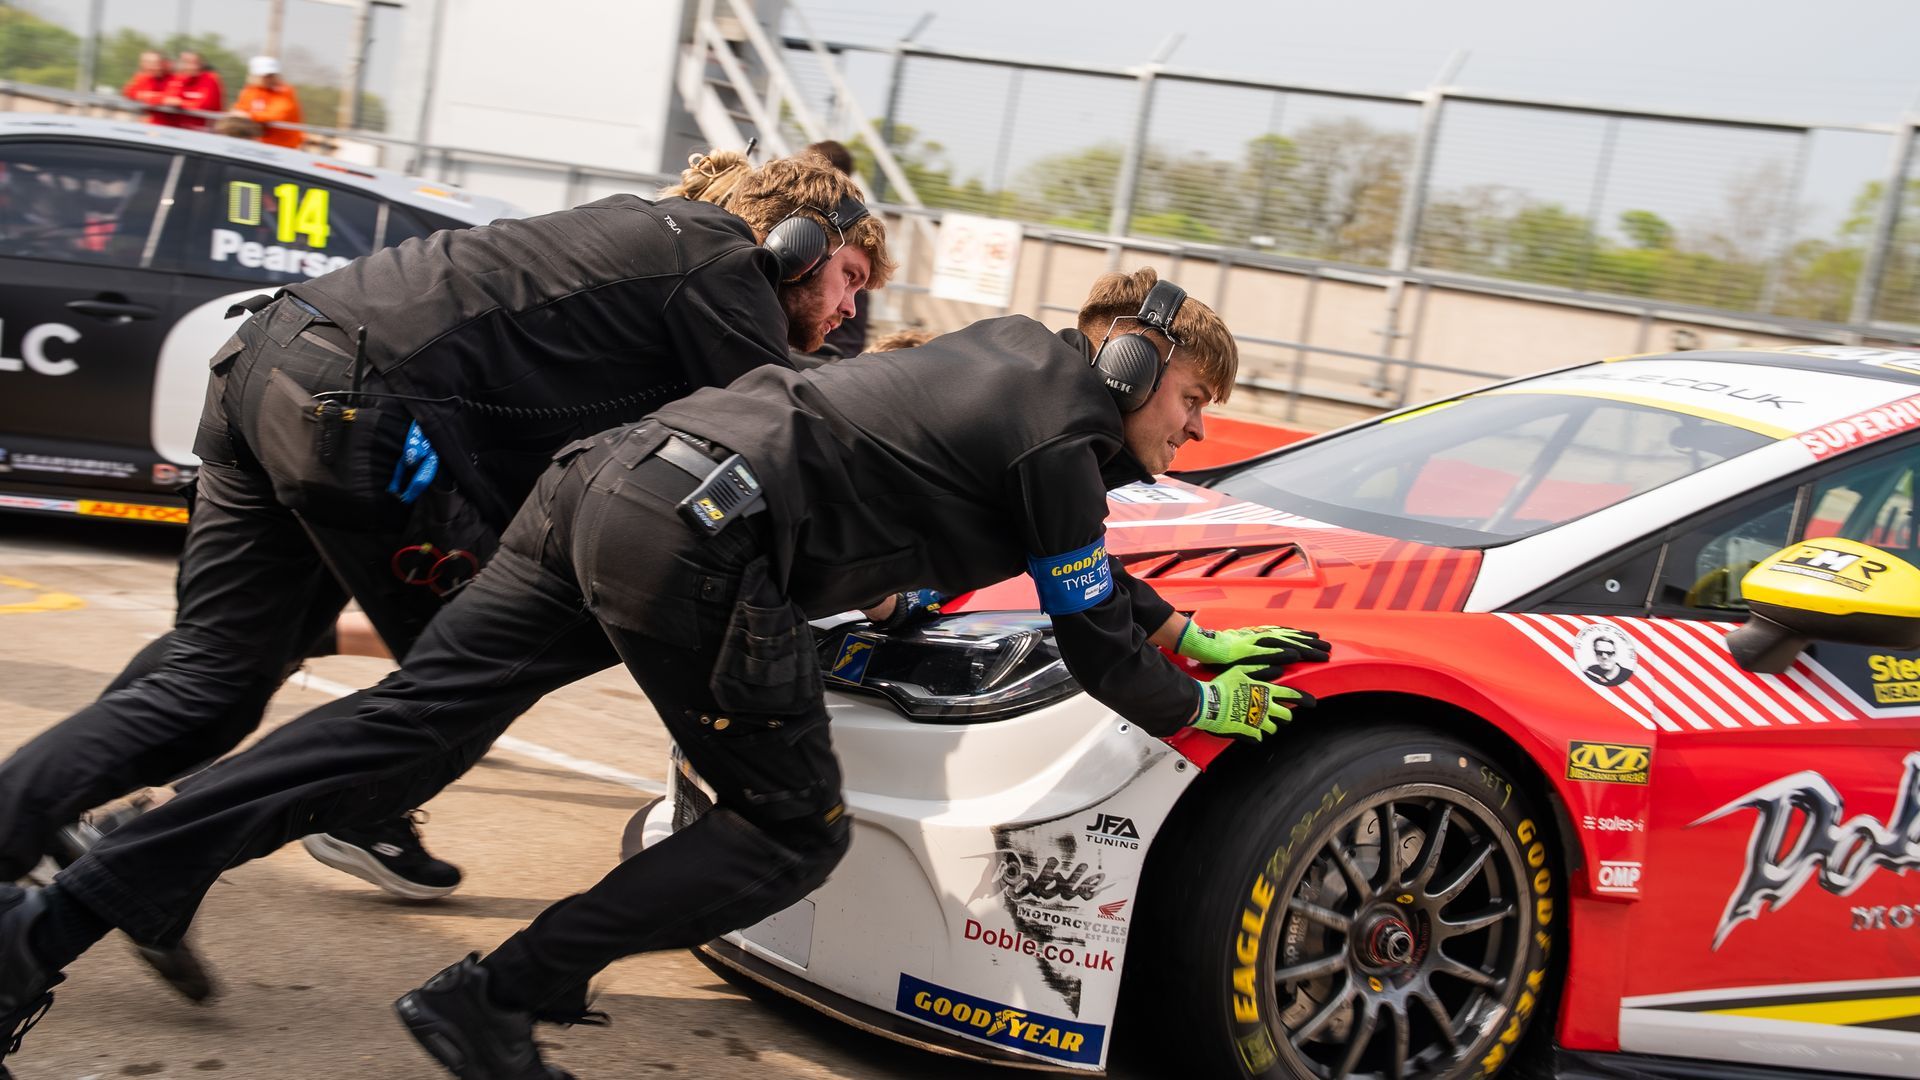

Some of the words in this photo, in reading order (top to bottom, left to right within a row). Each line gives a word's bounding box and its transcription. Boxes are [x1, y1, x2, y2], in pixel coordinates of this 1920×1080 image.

[274, 183, 330, 248] 14
[1062, 571, 1096, 591] TYRE
[1086, 813, 1140, 840] JFA
[1085, 834, 1139, 850] TUNING
[1599, 866, 1641, 888] OMP
[1017, 905, 1128, 937] MOTORCYCLES
[964, 919, 1116, 972] Doble.co.uk
[1233, 872, 1275, 1024] EAGLE
